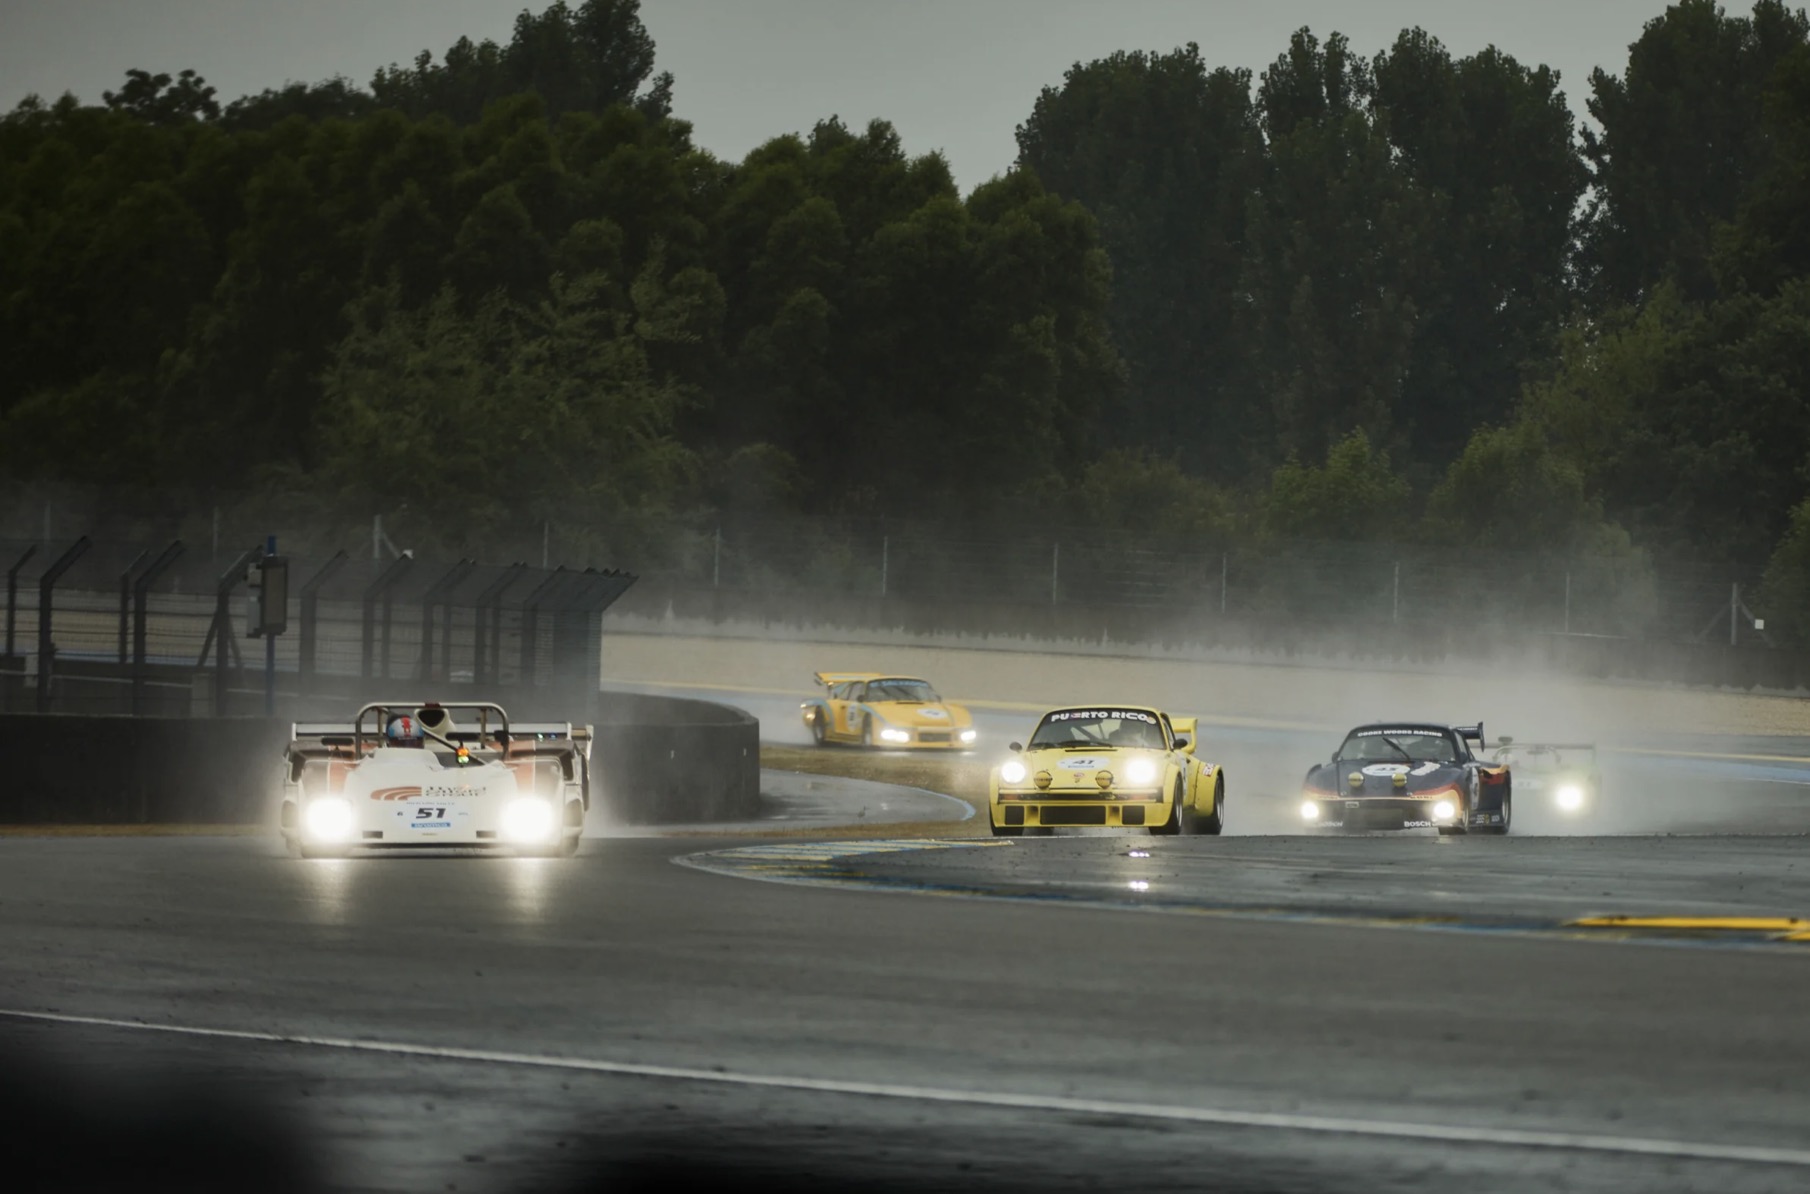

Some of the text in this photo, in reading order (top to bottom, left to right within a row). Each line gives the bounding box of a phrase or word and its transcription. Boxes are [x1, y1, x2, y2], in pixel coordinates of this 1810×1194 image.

[1051, 711, 1147, 722] PUERTO RICO
[415, 807, 446, 819] 51
[1404, 820, 1431, 828] BOSCH
